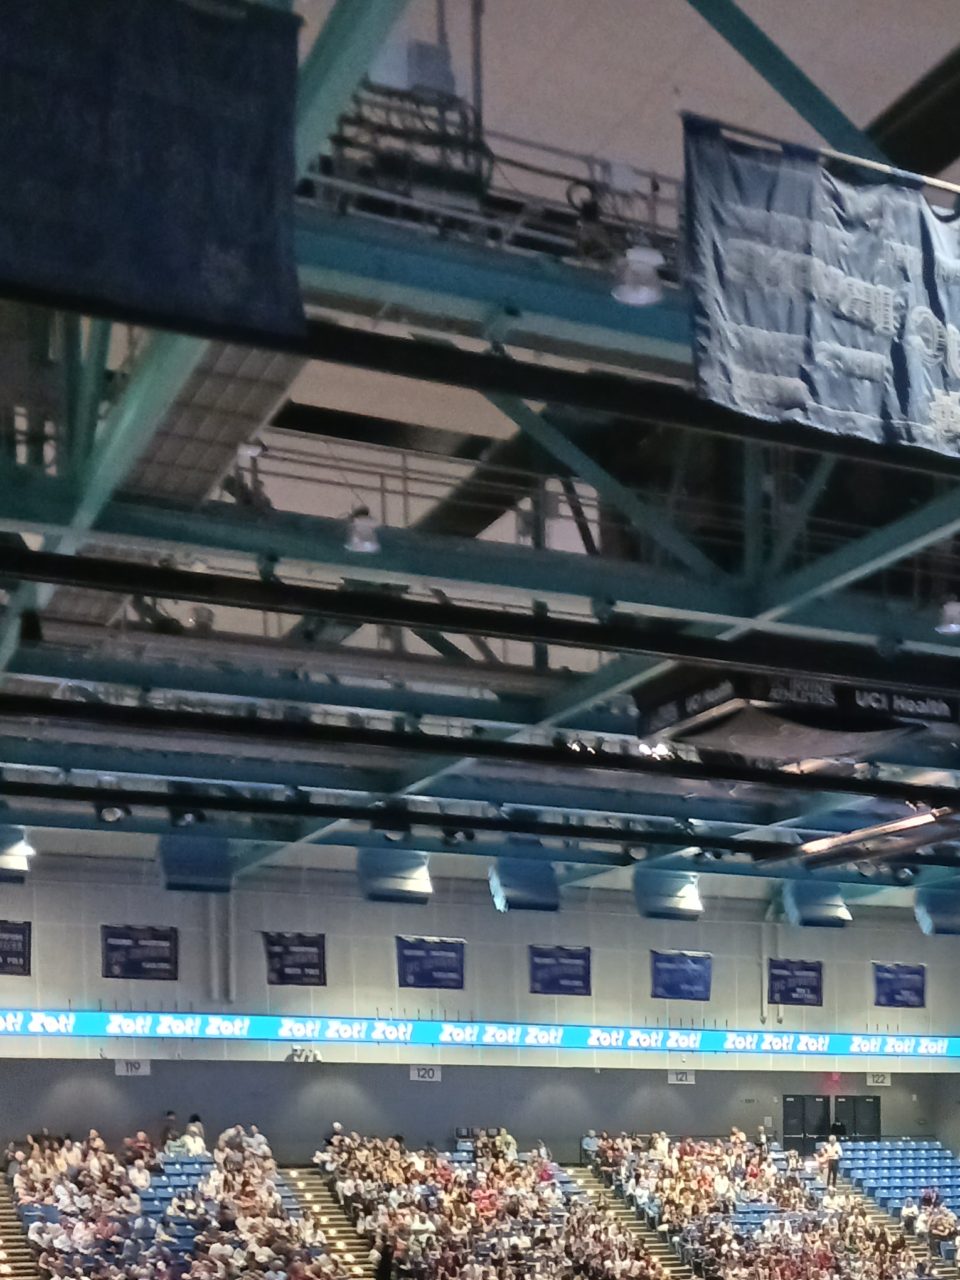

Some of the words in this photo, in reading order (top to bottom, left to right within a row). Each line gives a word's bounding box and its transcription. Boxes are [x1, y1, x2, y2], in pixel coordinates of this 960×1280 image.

[855, 689, 889, 711] UCI
[893, 694, 951, 717] Health
[0, 1012, 23, 1033] ot!
[29, 1013, 75, 1034] Zot!
[107, 1015, 152, 1036] Zot!
[156, 1016, 200, 1037] Zot!
[206, 1018, 249, 1038] Zot!
[279, 1020, 320, 1040] Zot!
[325, 1021, 366, 1041] Zot!
[371, 1022, 413, 1042] Zot!
[440, 1024, 478, 1044] Zot!
[483, 1026, 520, 1045] Zot!
[525, 1027, 563, 1046] Zot!
[588, 1029, 623, 1047] Zot!
[628, 1030, 663, 1048] Zot!
[666, 1031, 700, 1049] Zot!
[725, 1033, 757, 1051] Zot!
[761, 1034, 793, 1051] Zot!
[798, 1035, 829, 1052] Zot!
[850, 1036, 880, 1054] Zot!
[885, 1037, 914, 1054] Zot!
[918, 1038, 948, 1055] Zot!
[416, 1067, 435, 1079] 120
[871, 1073, 886, 1084] 122
